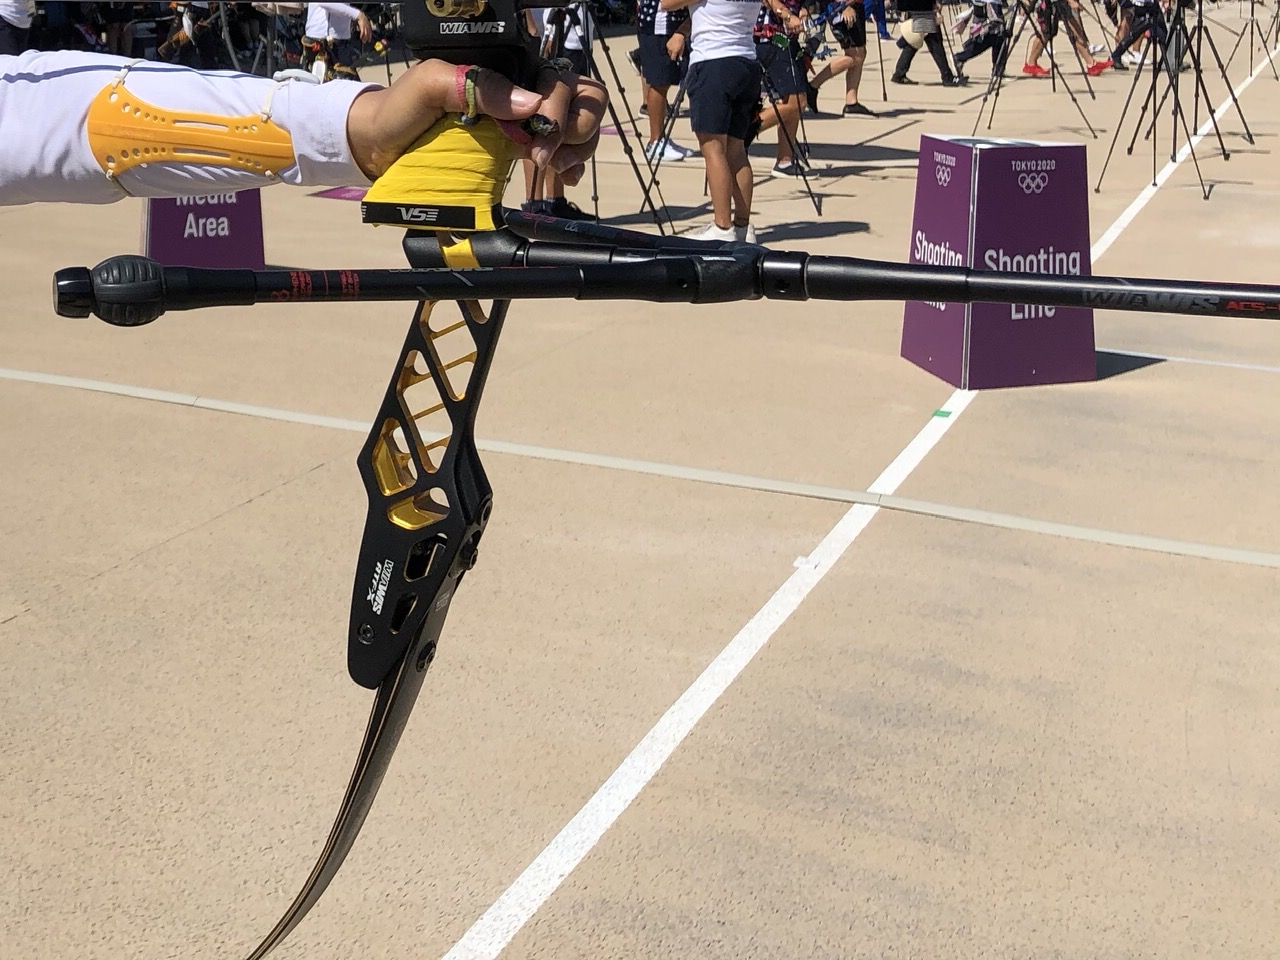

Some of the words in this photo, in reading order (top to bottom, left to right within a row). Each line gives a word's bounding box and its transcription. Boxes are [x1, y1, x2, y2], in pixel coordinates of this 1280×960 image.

[439, 21, 506, 34] WIAWIS
[933, 151, 945, 163] TOKYO
[1011, 160, 1036, 171] TOKYO
[1037, 159, 1056, 170] 2020
[183, 212, 229, 238] Area
[914, 230, 963, 267] Shooting
[984, 245, 1081, 276] Shooting
[1082, 289, 1220, 312] WIAWIS
[366, 561, 382, 606] ATF-X
[372, 559, 395, 616] WIAWIS
